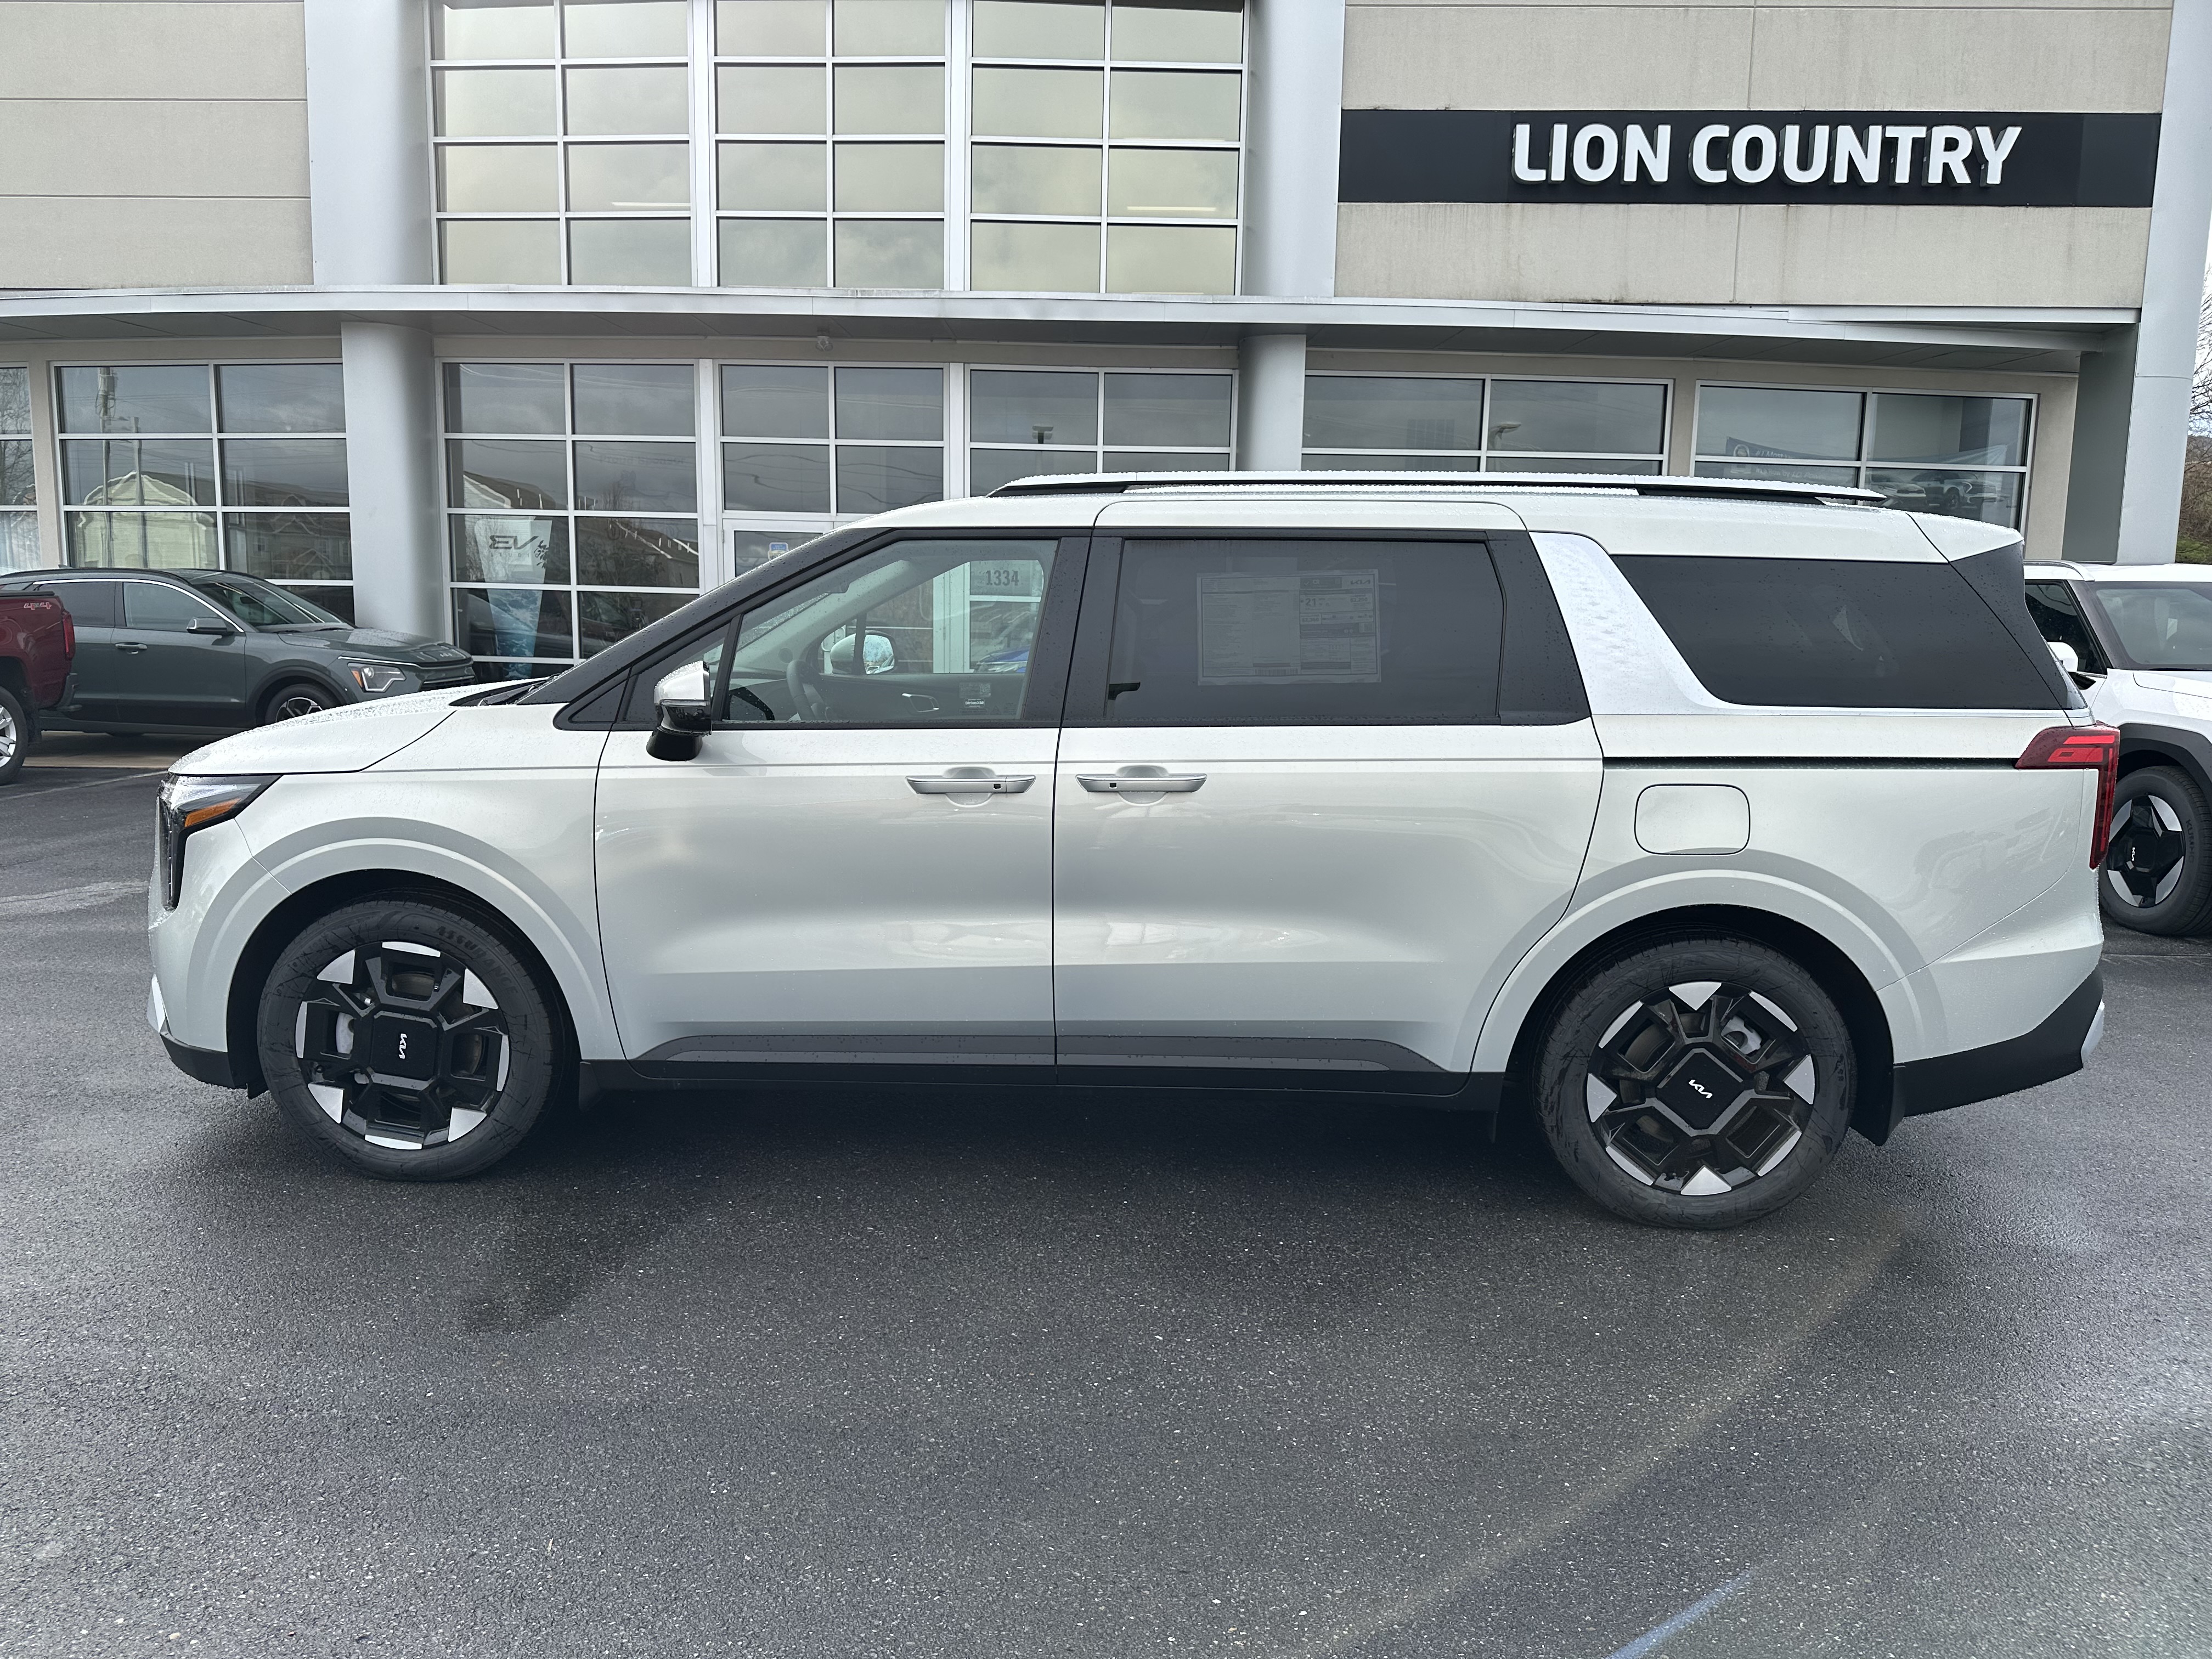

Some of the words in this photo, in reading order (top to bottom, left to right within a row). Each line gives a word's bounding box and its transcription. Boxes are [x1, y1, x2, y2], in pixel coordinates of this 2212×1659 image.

[1514, 123, 1672, 183] LION
[1690, 123, 2022, 185] COUNTRY
[489, 535, 539, 550] EV
[986, 569, 1019, 586] 1334
